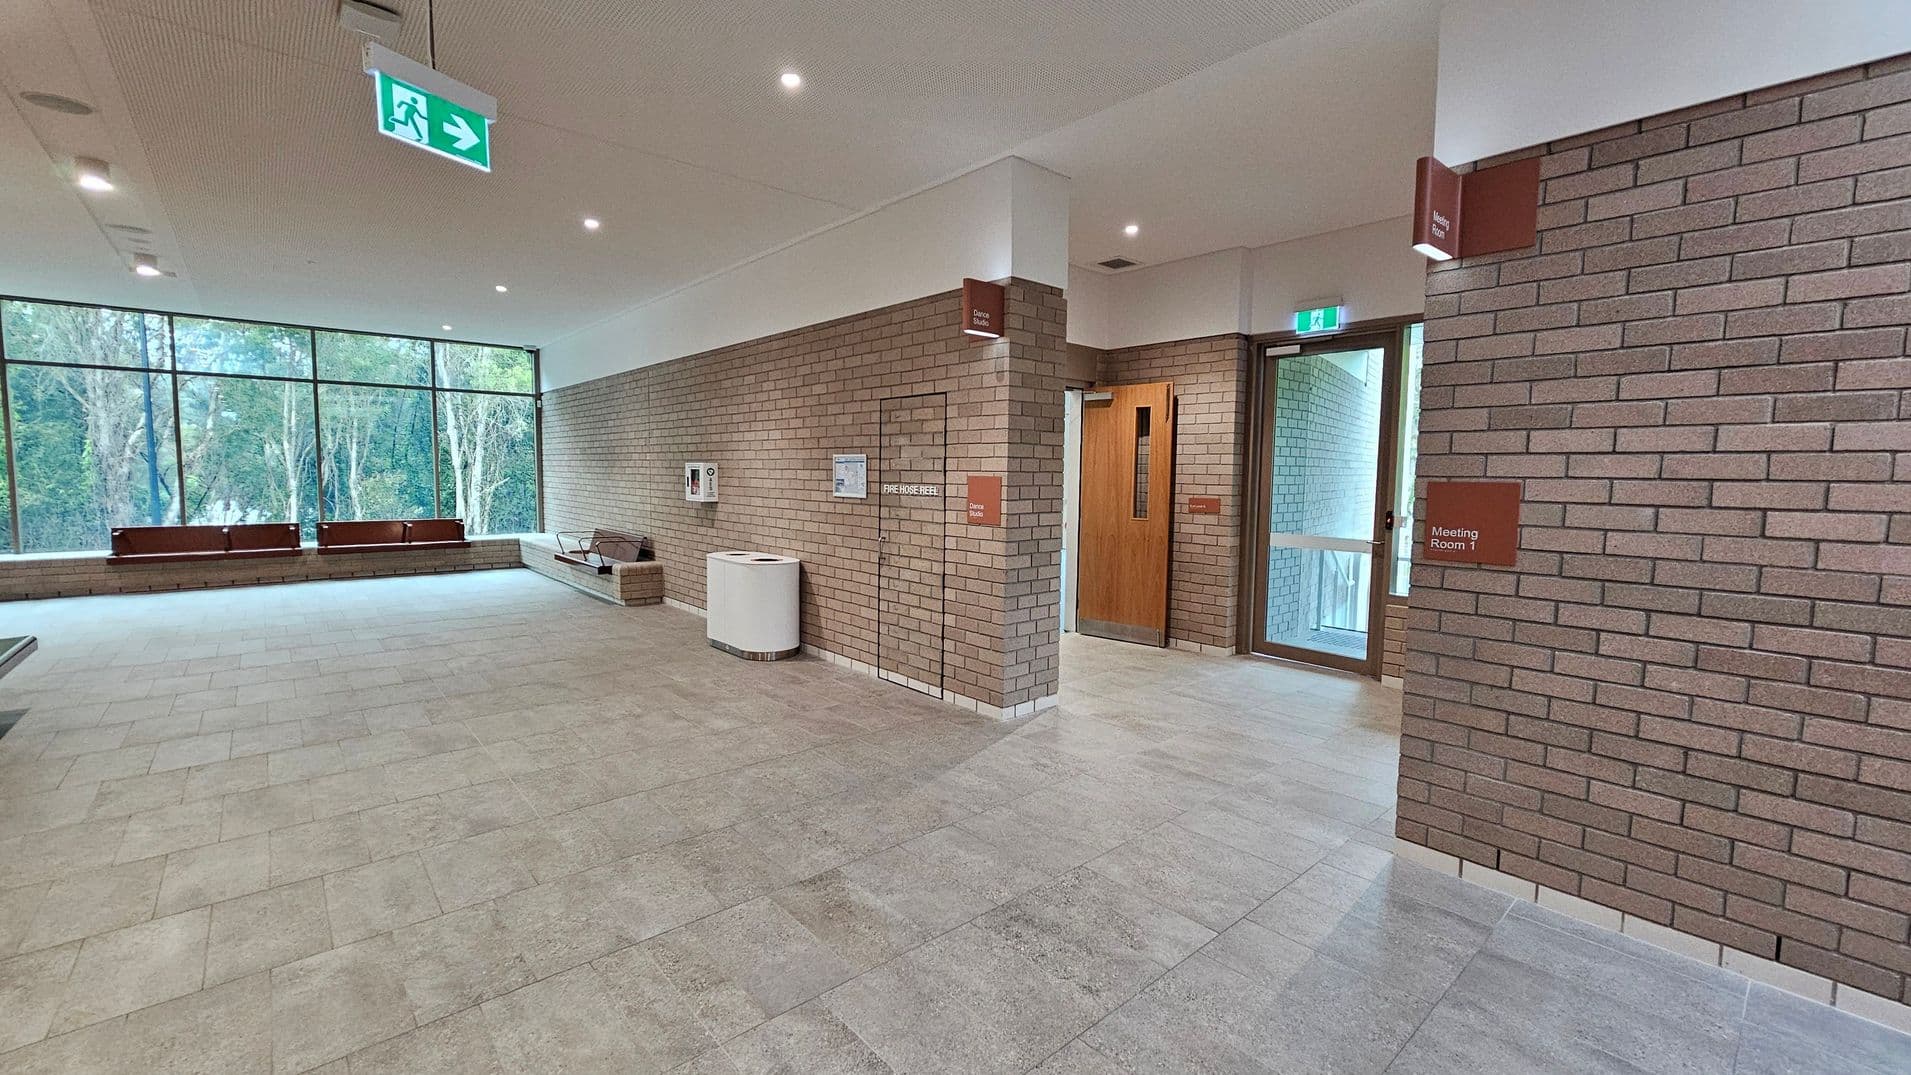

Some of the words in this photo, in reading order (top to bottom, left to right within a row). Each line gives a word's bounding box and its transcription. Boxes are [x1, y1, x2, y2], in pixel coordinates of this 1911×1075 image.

[883, 484, 899, 494] FIRE
[900, 485, 920, 496] HOSE
[920, 486, 939, 496] REEL
[1431, 526, 1479, 540] Meeting
[1430, 538, 1465, 550] Room
[1470, 541, 1476, 551] 1
